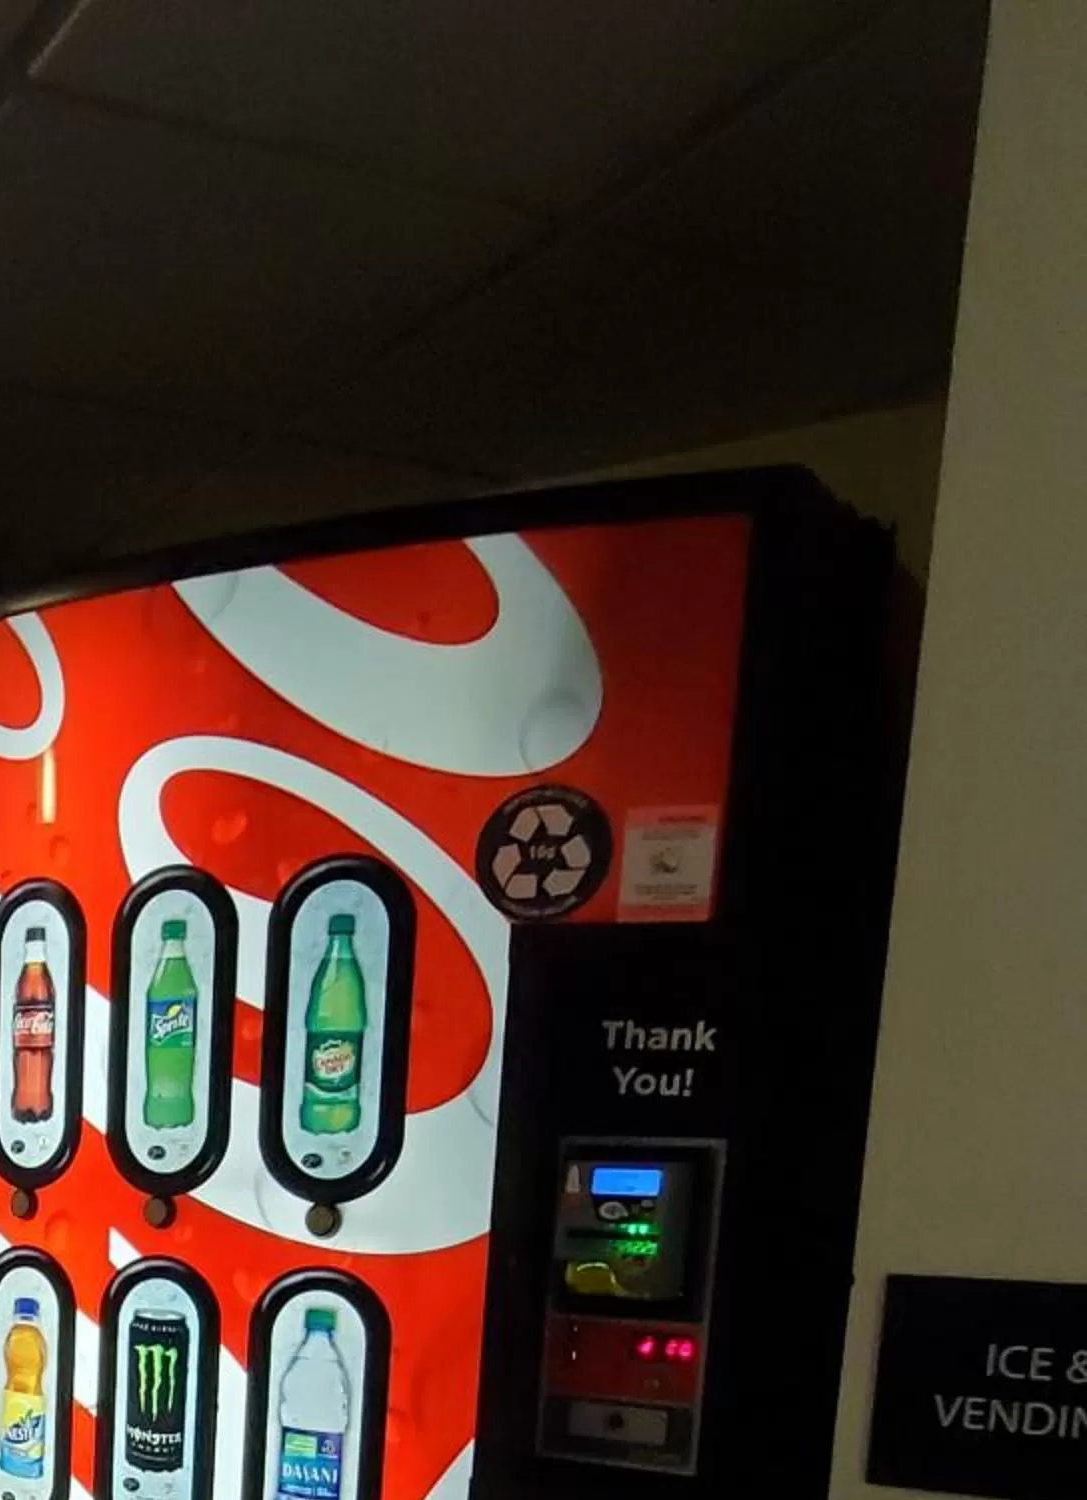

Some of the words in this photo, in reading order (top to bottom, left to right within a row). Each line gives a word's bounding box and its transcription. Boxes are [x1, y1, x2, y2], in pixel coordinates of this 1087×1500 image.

[153, 1005, 191, 1038] Sprite
[602, 1019, 718, 1050] Thank
[613, 1065, 694, 1097] You!
[985, 1343, 1055, 1381] ICE
[1065, 1349, 1087, 1384] &
